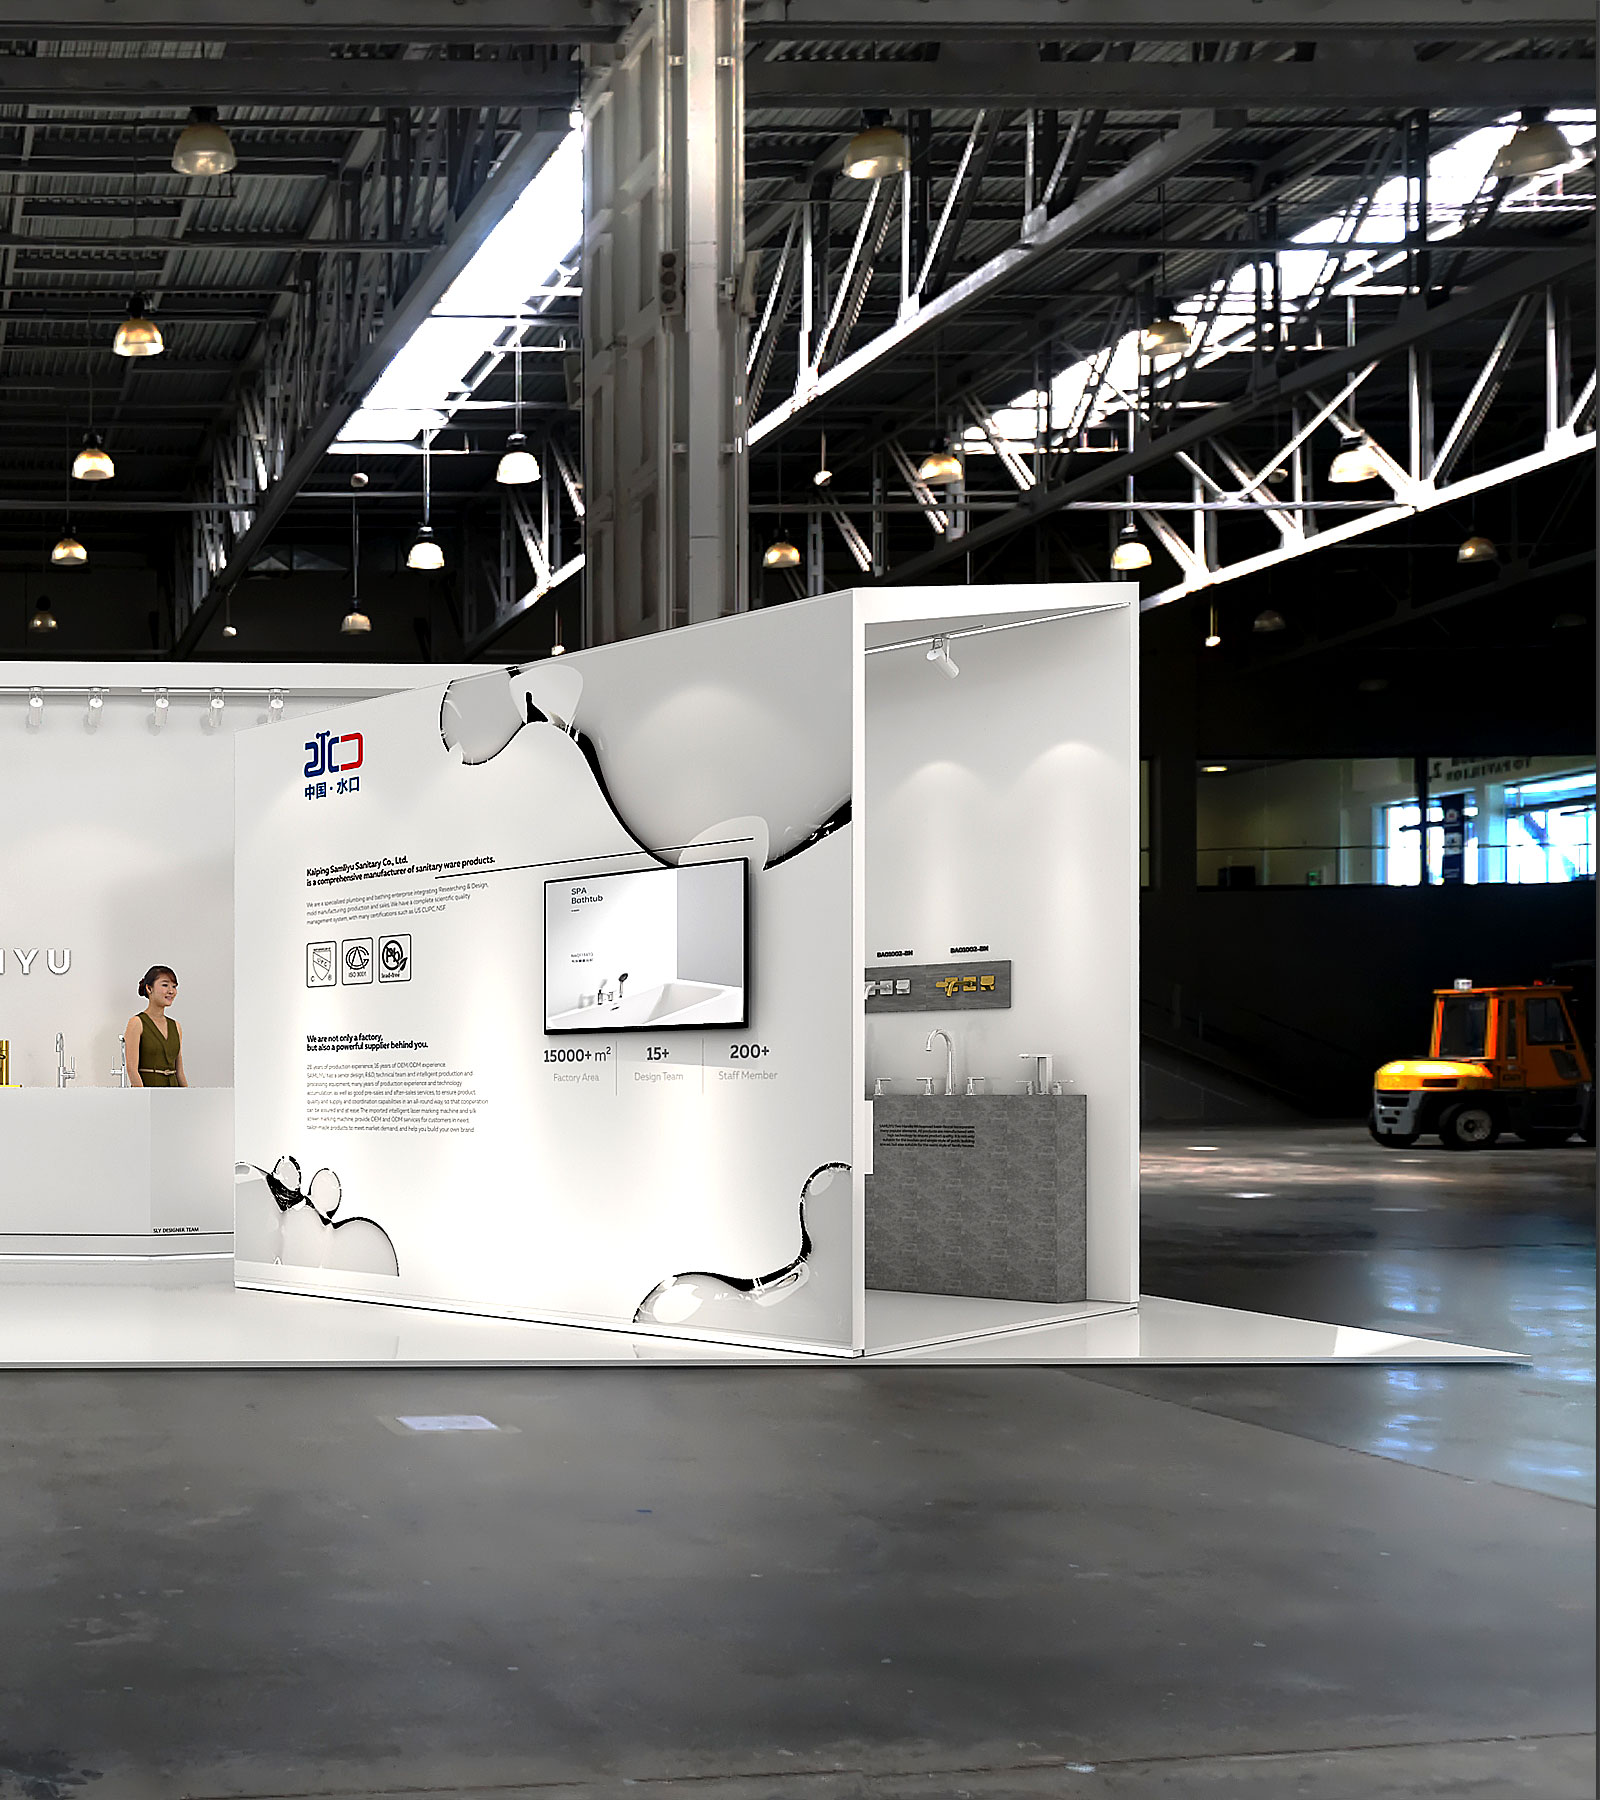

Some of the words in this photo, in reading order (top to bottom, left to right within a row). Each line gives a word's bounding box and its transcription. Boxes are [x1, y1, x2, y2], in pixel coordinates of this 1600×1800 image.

[304, 776, 360, 800] 中国·水口
[355, 861, 381, 869] Sanitary
[395, 855, 408, 864] Ltd.
[317, 873, 362, 885] comprehensive
[363, 868, 406, 879] manufacturer
[407, 865, 415, 873] of
[416, 863, 443, 872] sanitary
[444, 861, 460, 869] ware
[461, 856, 495, 869] products.
[571, 887, 587, 896] SPA
[571, 894, 603, 905] Bathtub
[340, 1034, 353, 1043] only
[359, 1033, 383, 1042] factory,
[306, 1043, 317, 1051] but
[318, 1043, 330, 1051] also
[336, 1042, 363, 1052] powerful
[364, 1042, 389, 1051] supplier
[391, 1040, 413, 1049] behind
[414, 1042, 428, 1050] you.
[730, 1044, 770, 1059] 200+
[543, 1049, 592, 1063] 15000+
[646, 1047, 670, 1061] 15+
[553, 1073, 582, 1083] Factory
[634, 1072, 661, 1082] Design
[662, 1072, 684, 1081] Team
[718, 1071, 740, 1080] Staff
[741, 1070, 778, 1080] Member
